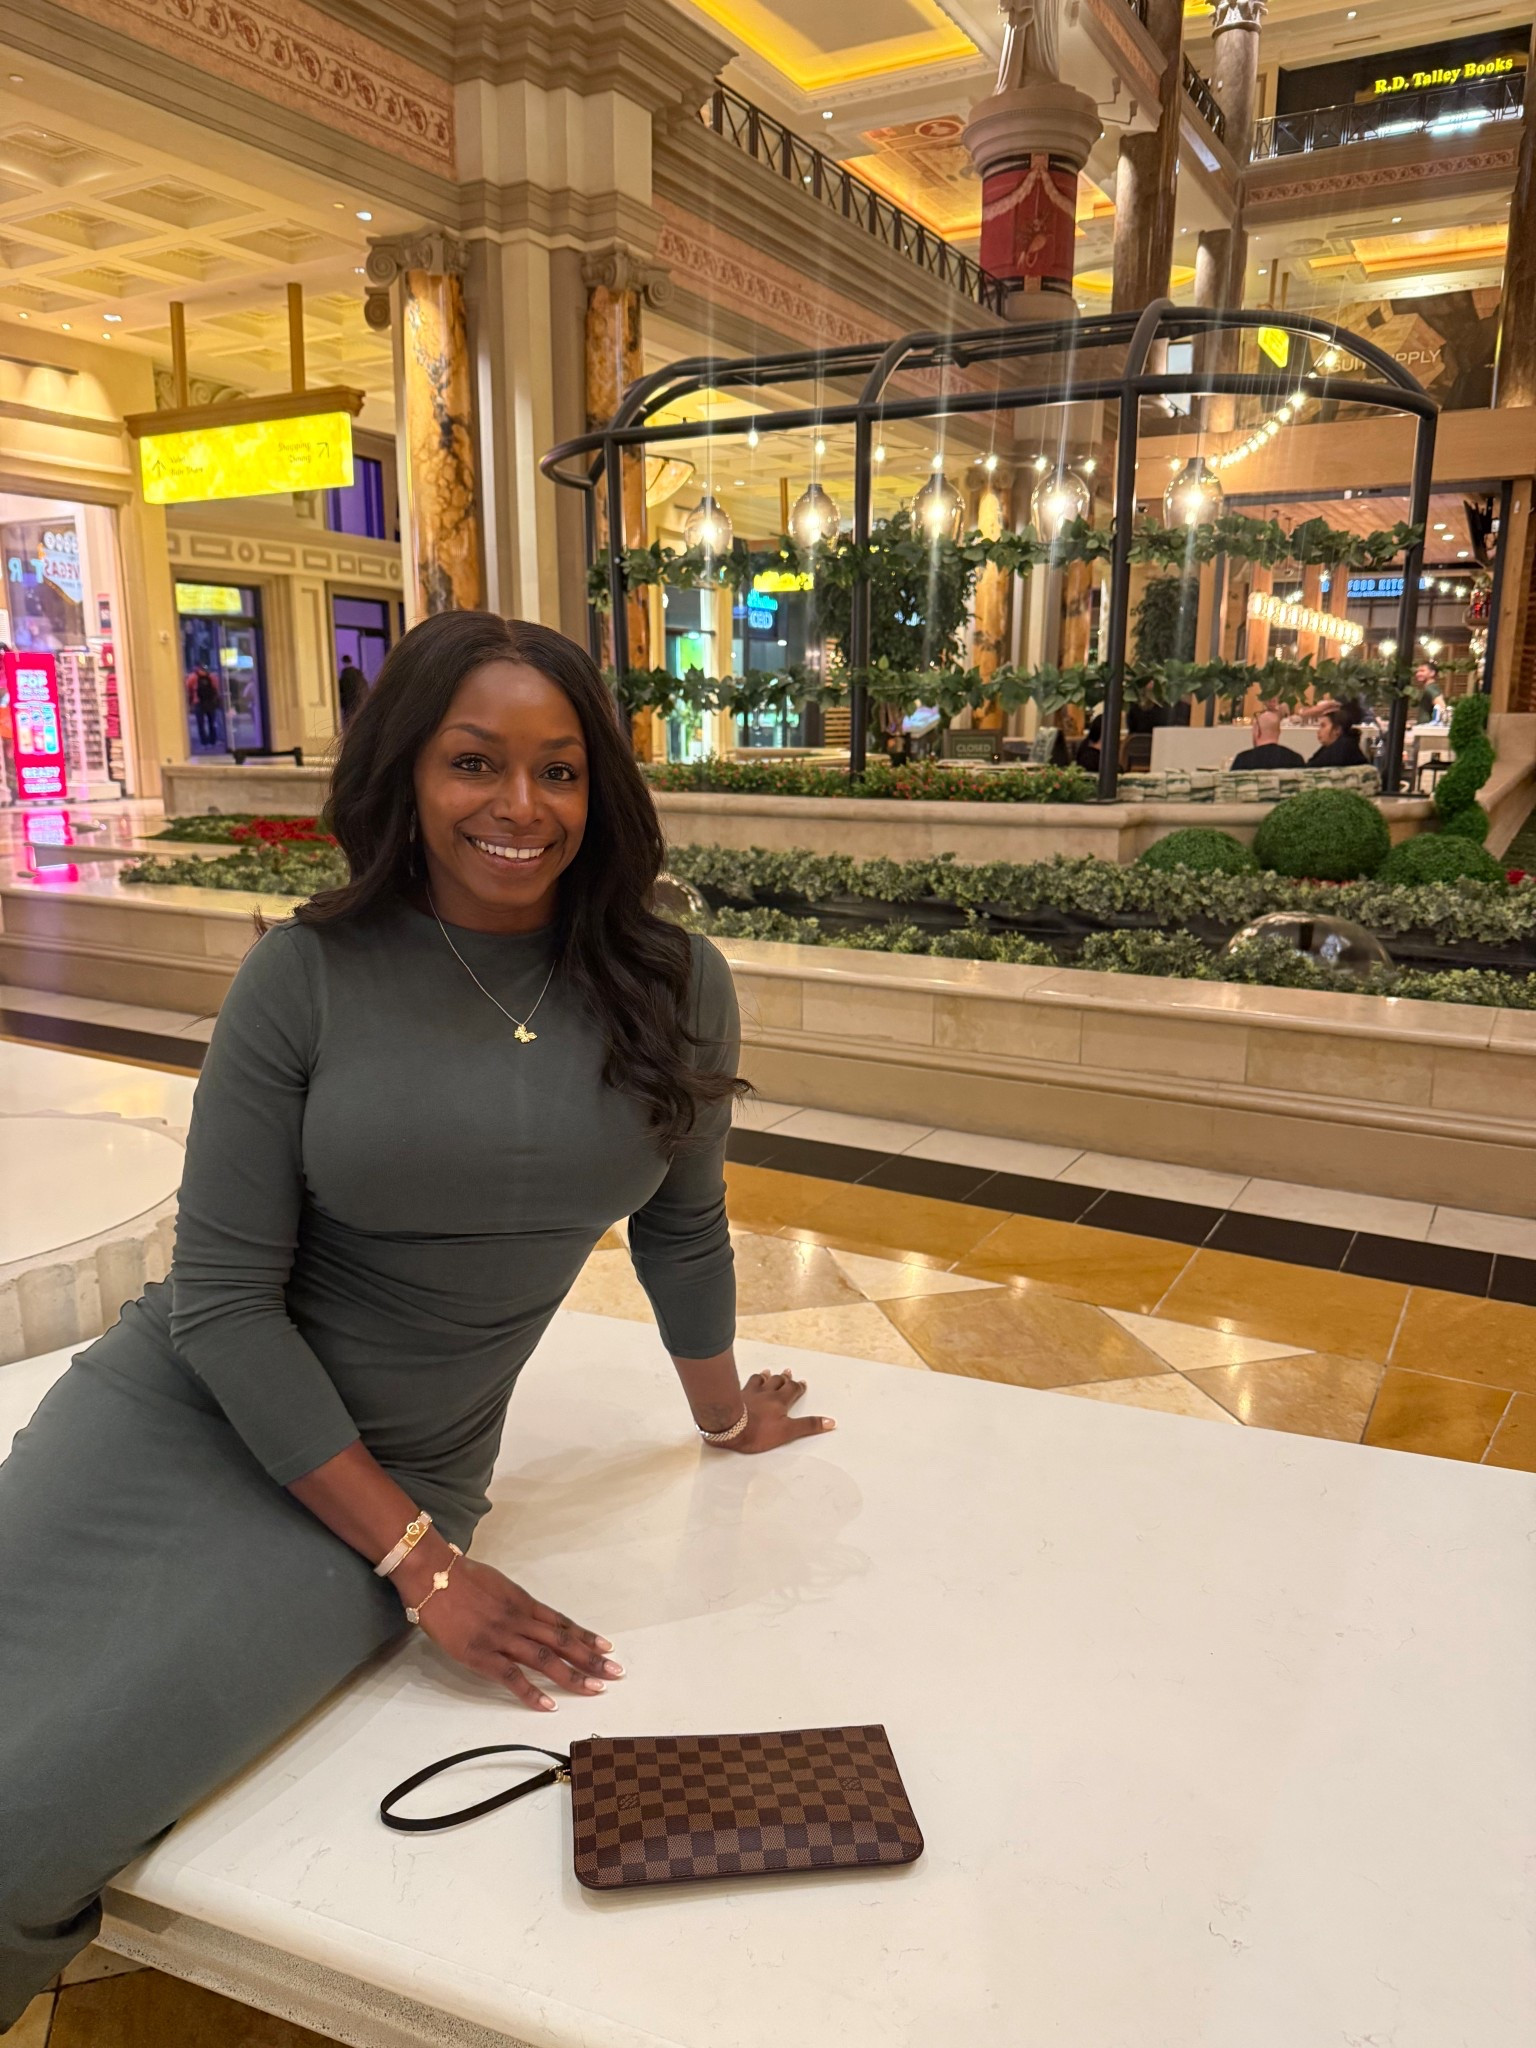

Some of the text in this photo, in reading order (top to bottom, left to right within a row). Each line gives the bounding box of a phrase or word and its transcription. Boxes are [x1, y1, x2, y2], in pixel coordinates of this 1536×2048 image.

[1374, 58, 1513, 94] R.D. Talley Books
